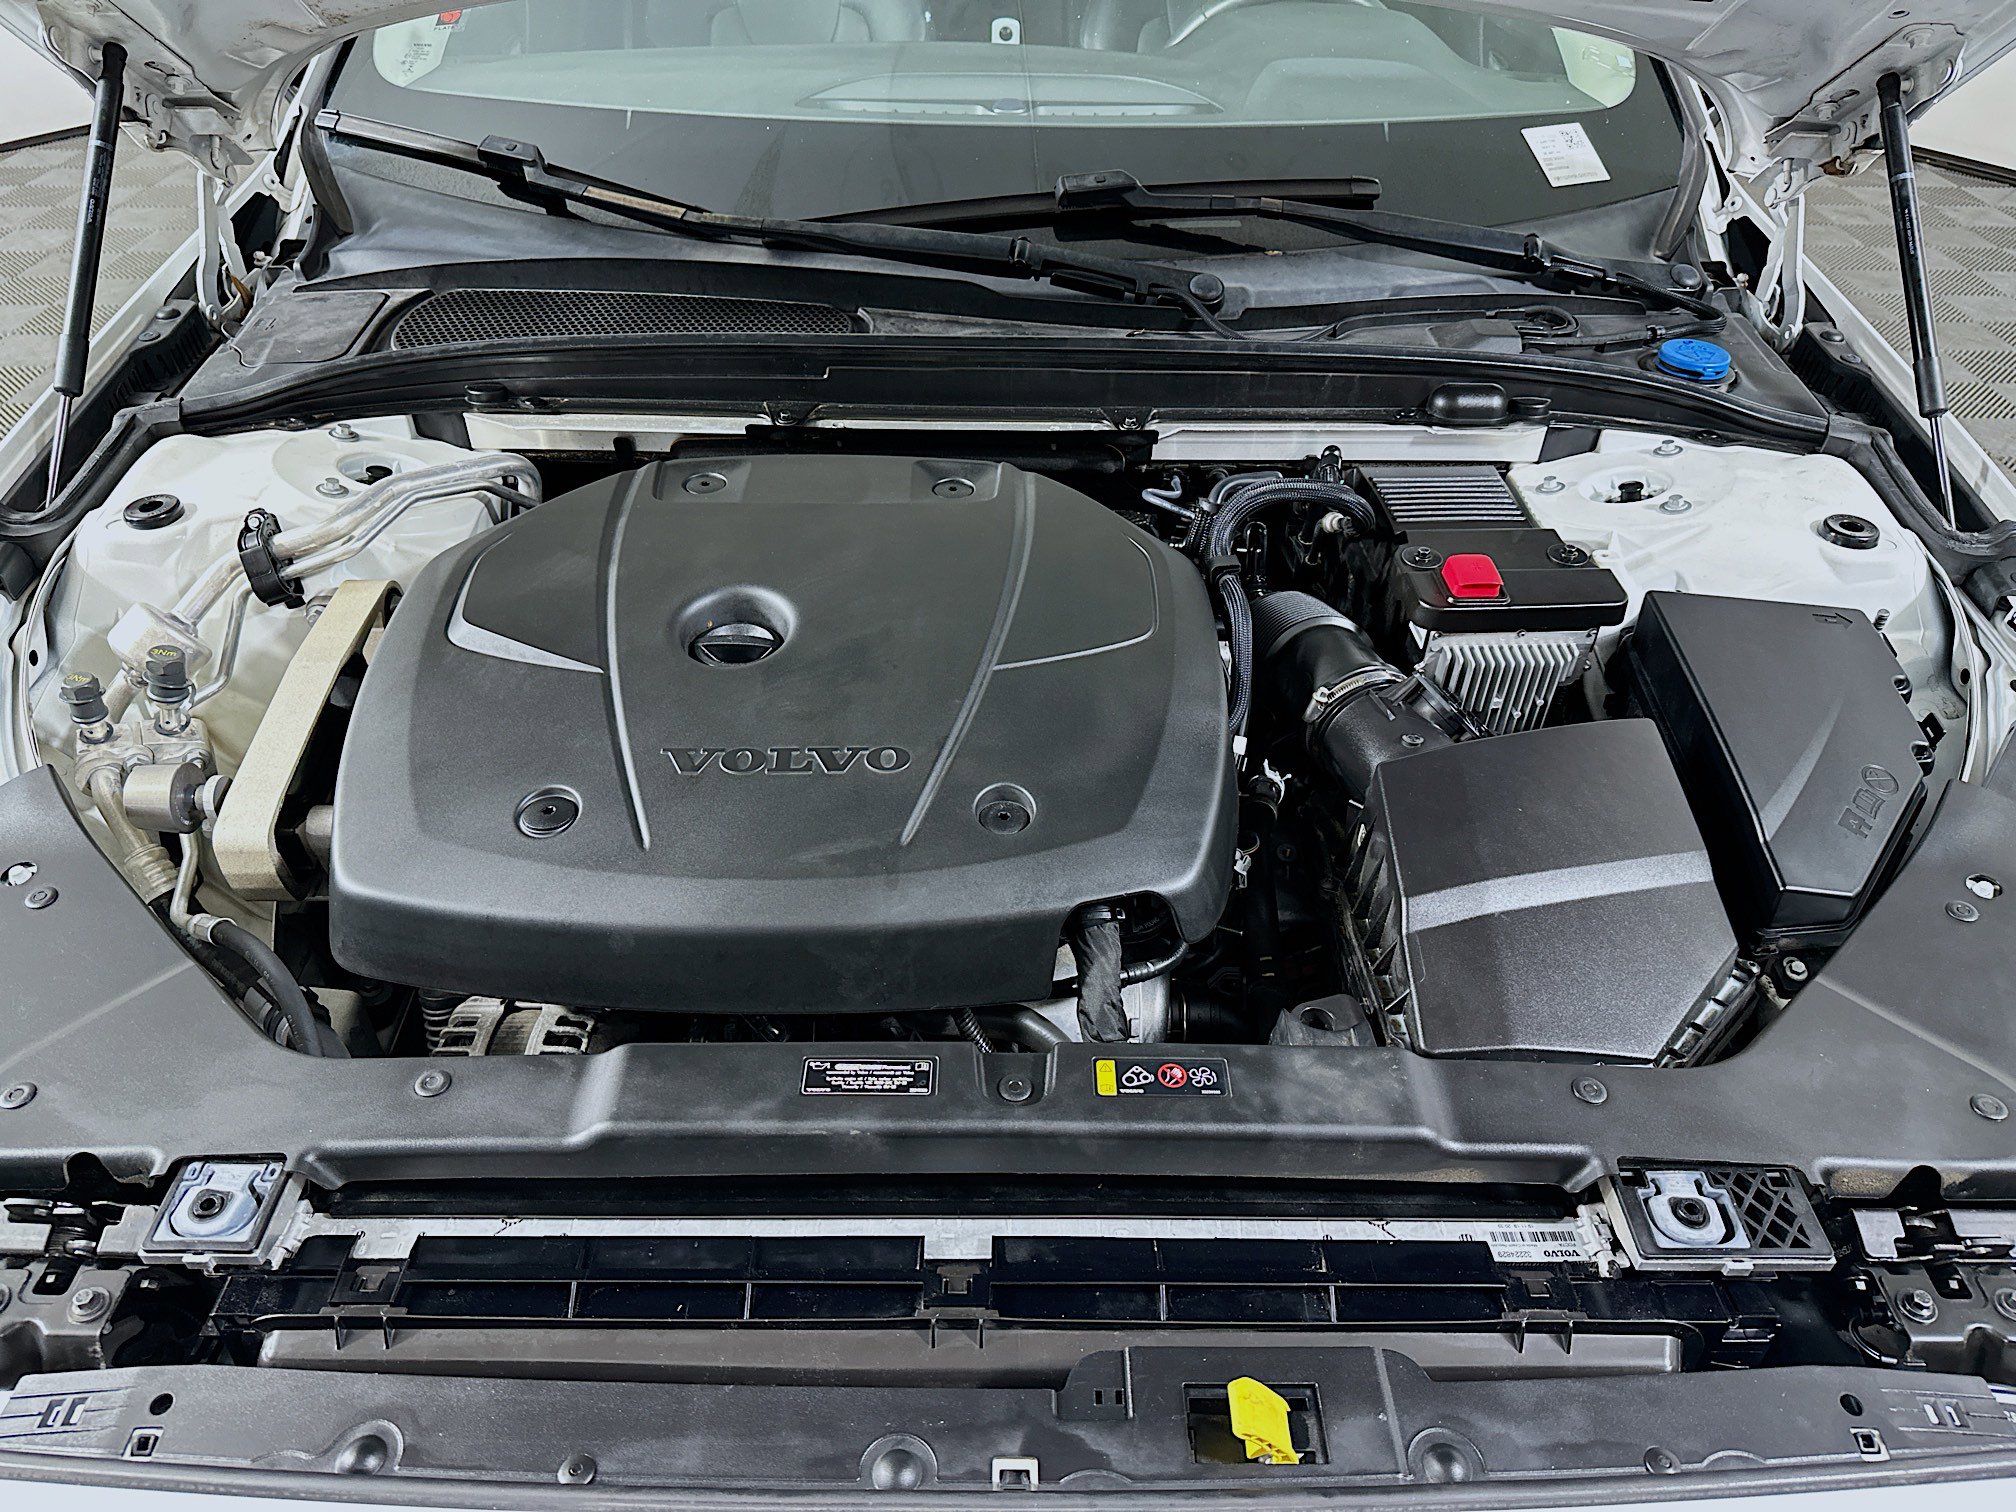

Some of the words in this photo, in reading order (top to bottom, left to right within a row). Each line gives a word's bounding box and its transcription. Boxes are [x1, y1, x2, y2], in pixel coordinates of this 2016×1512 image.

[151, 648, 177, 657] 3Nm
[660, 746, 911, 775] VOLVO
[1543, 1249, 1581, 1257] VOLVO
